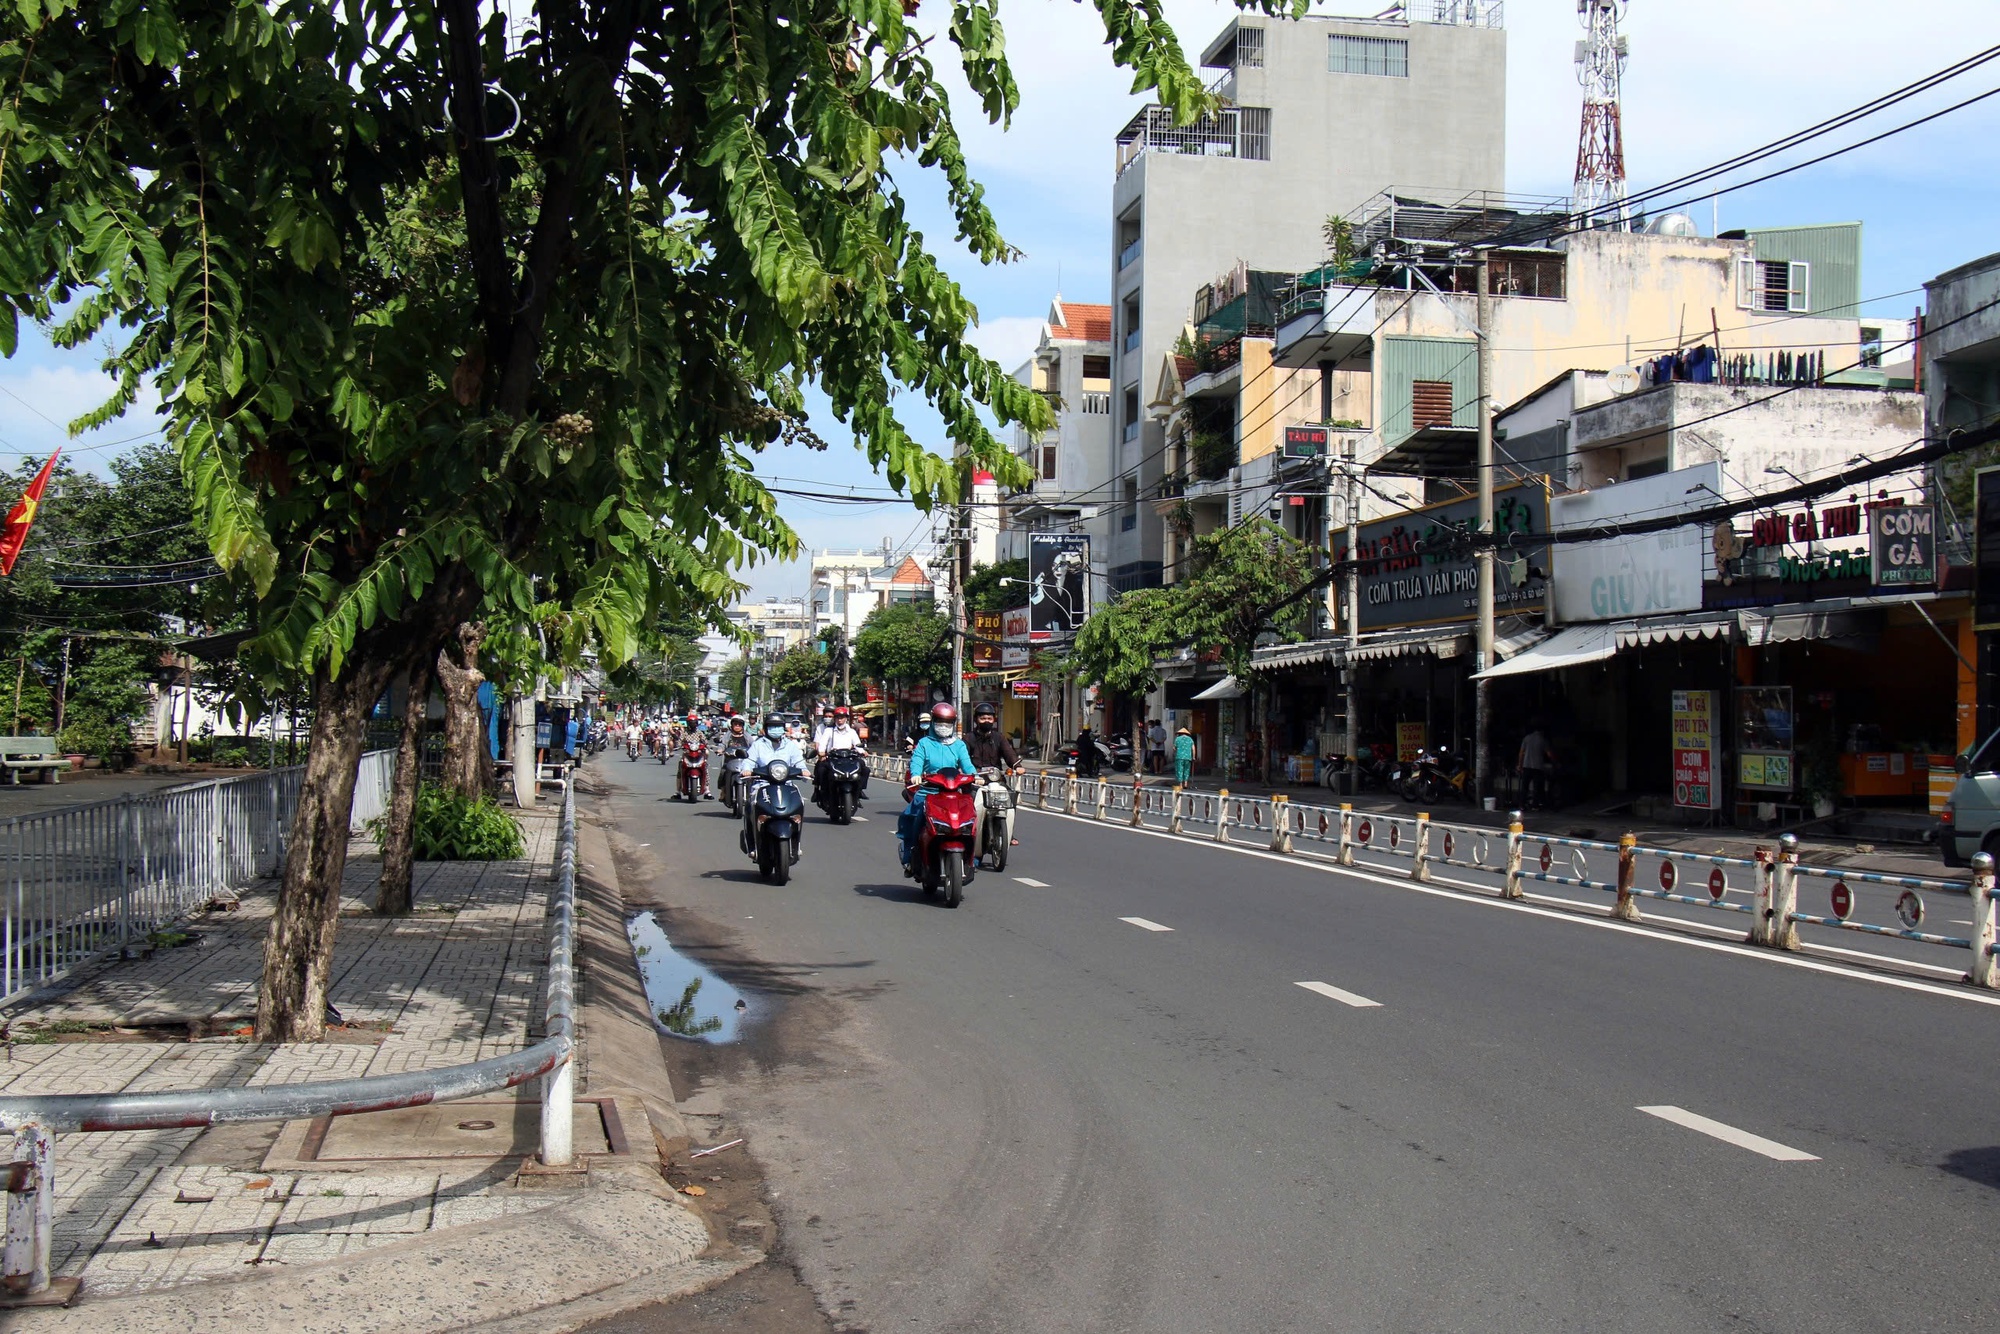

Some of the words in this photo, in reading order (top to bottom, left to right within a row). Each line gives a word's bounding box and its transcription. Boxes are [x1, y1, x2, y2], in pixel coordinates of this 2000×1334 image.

[1793, 500, 1818, 542] GÀ
[1881, 510, 1931, 535] CƠM
[1889, 537, 1924, 565] GÀ
[1368, 579, 1390, 604] CƠM
[1394, 577, 1422, 601] TRƯA
[977, 613, 1000, 628] PHỞ
[985, 647, 992, 658] 2
[1682, 752, 1702, 767] CƠM
